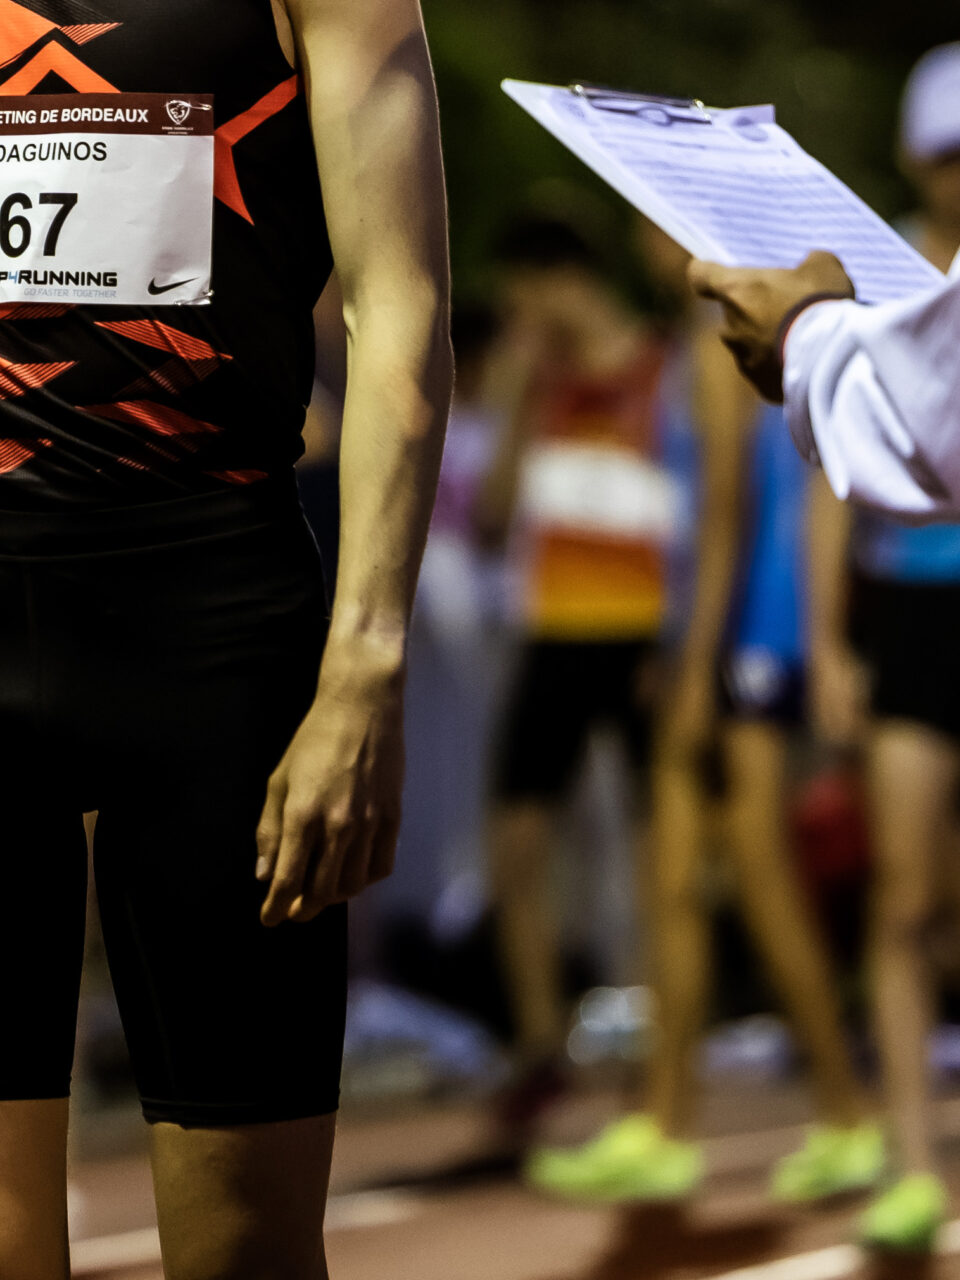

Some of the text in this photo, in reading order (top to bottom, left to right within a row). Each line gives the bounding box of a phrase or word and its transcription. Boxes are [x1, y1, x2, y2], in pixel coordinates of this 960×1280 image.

[39, 108, 59, 124] DE
[61, 107, 149, 123] BORDEAUX
[72, 288, 118, 298] TOGETHER
